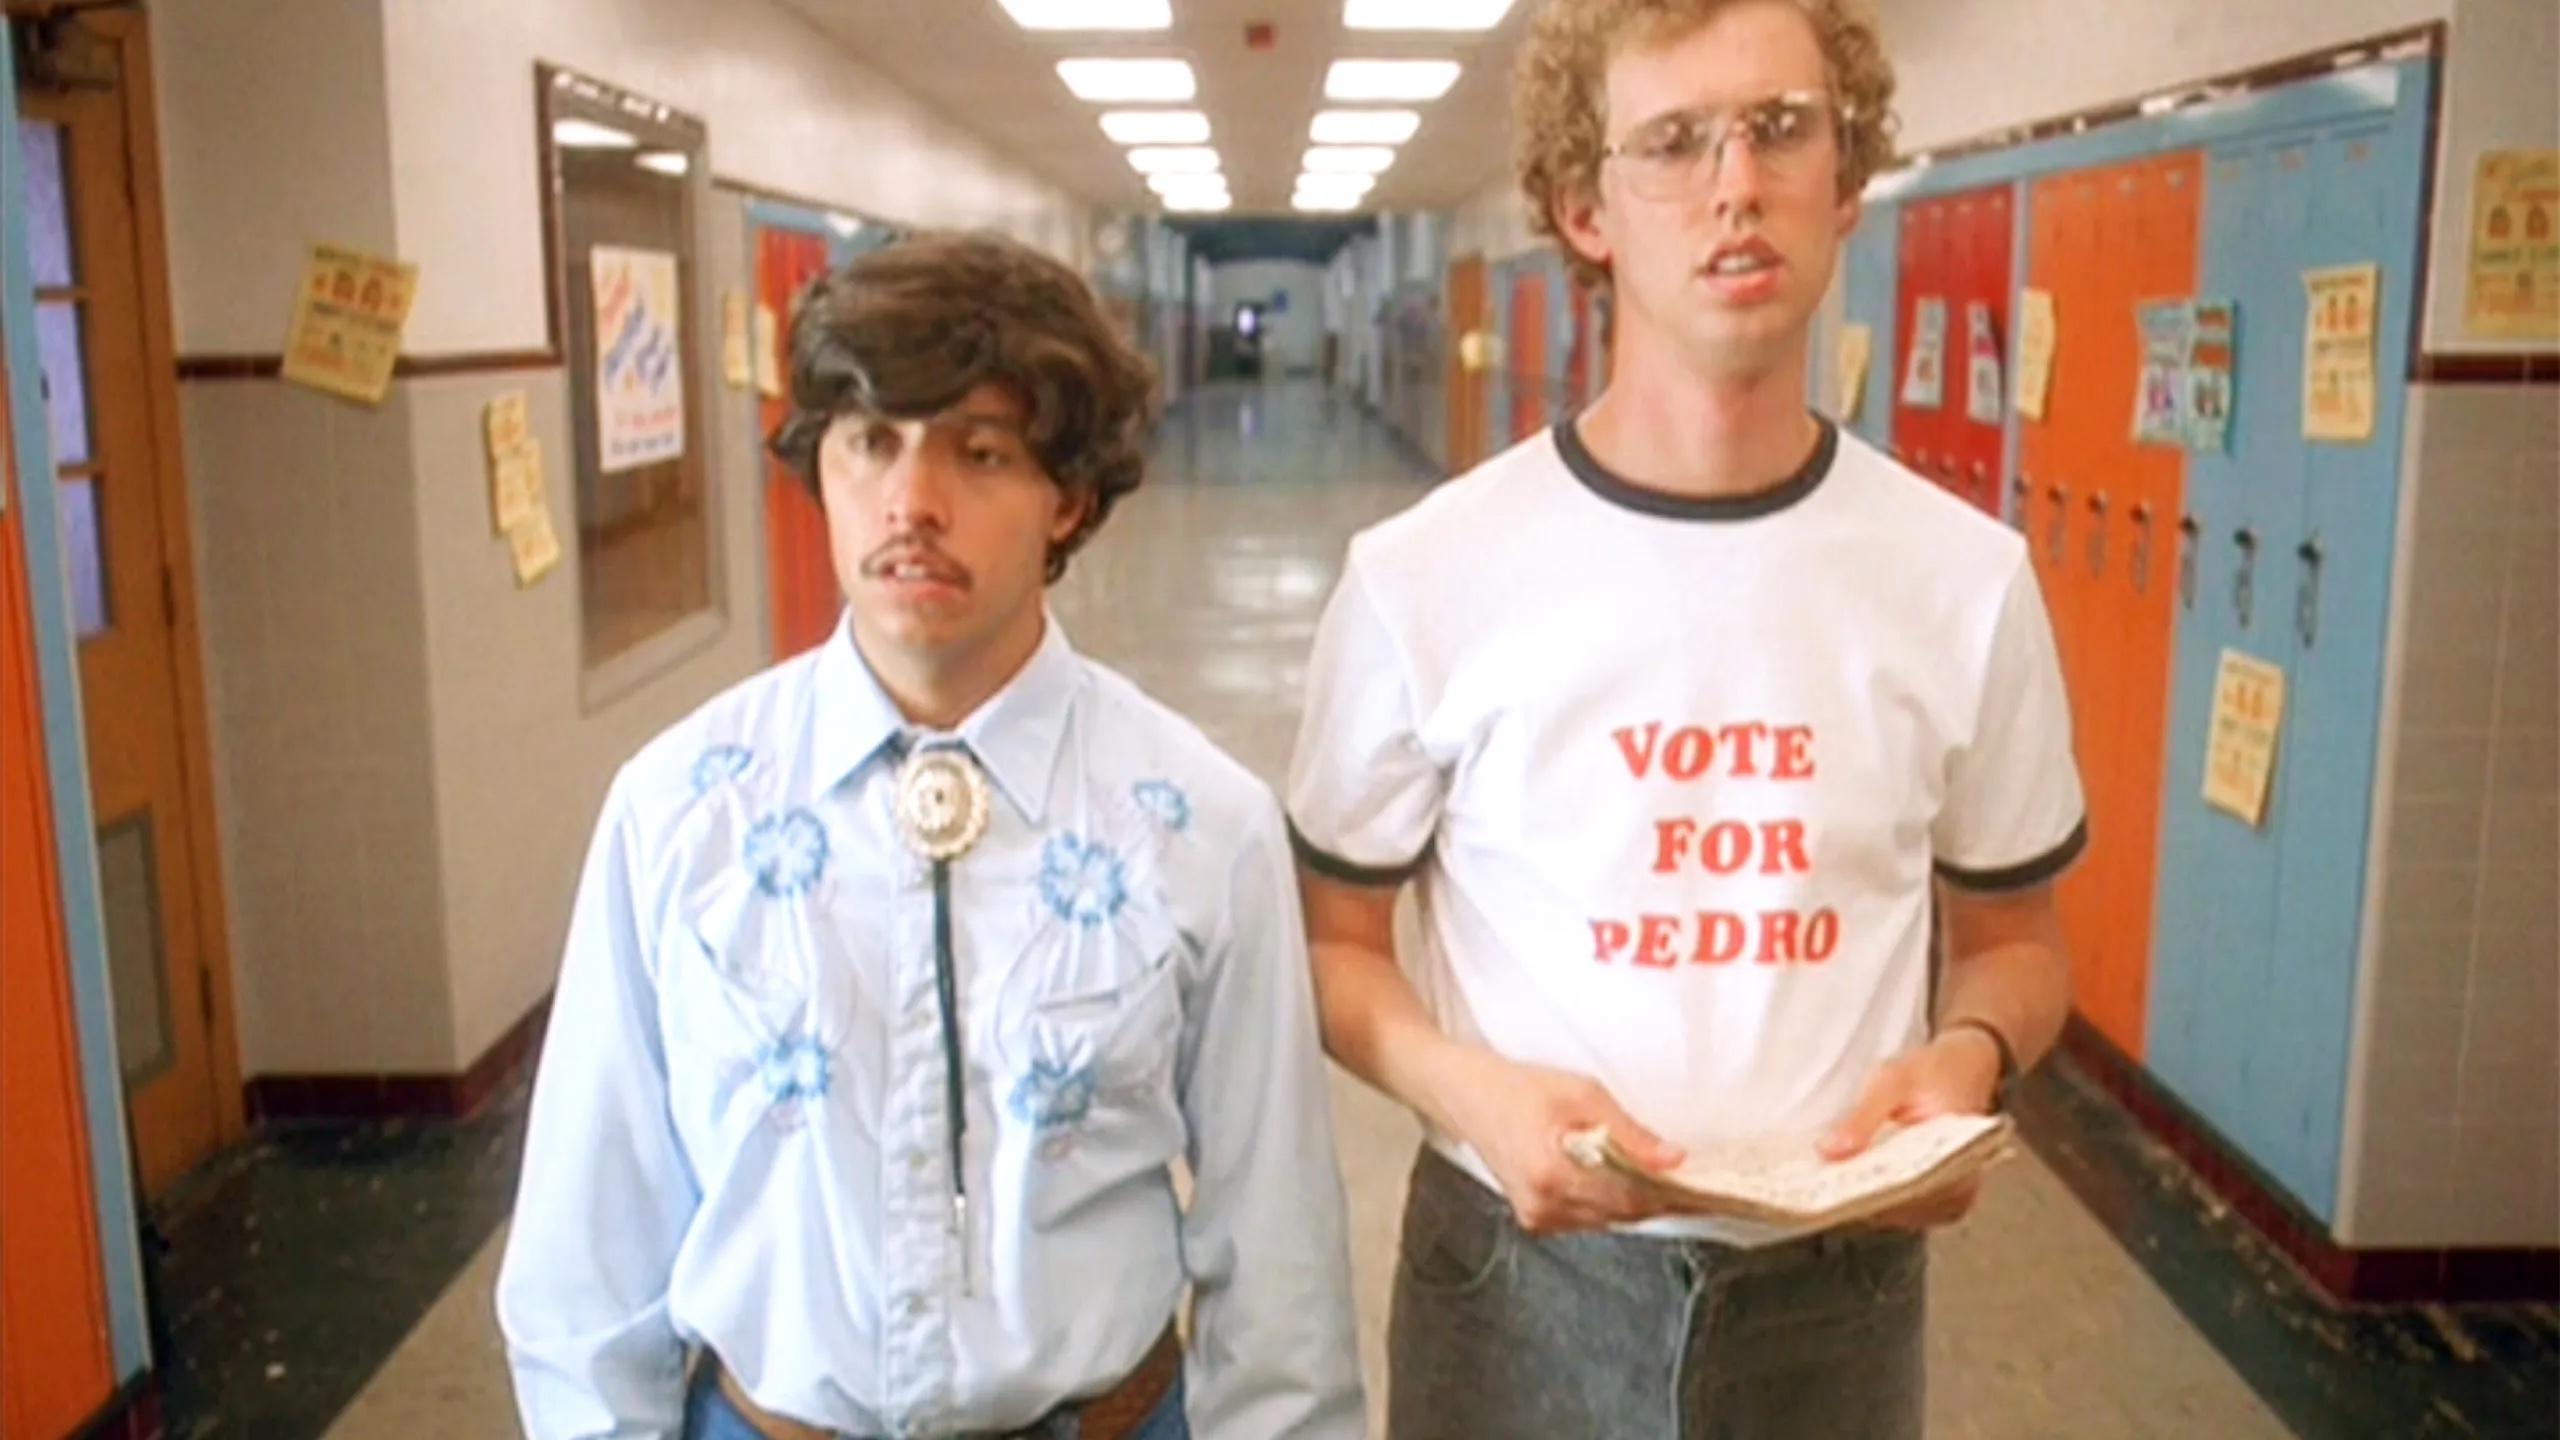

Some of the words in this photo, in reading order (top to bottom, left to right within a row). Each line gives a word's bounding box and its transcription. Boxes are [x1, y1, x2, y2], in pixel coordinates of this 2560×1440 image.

[1610, 720, 1816, 782] VOTE
[1652, 816, 1811, 875] FOR
[1588, 906, 1839, 968] PEDRO
